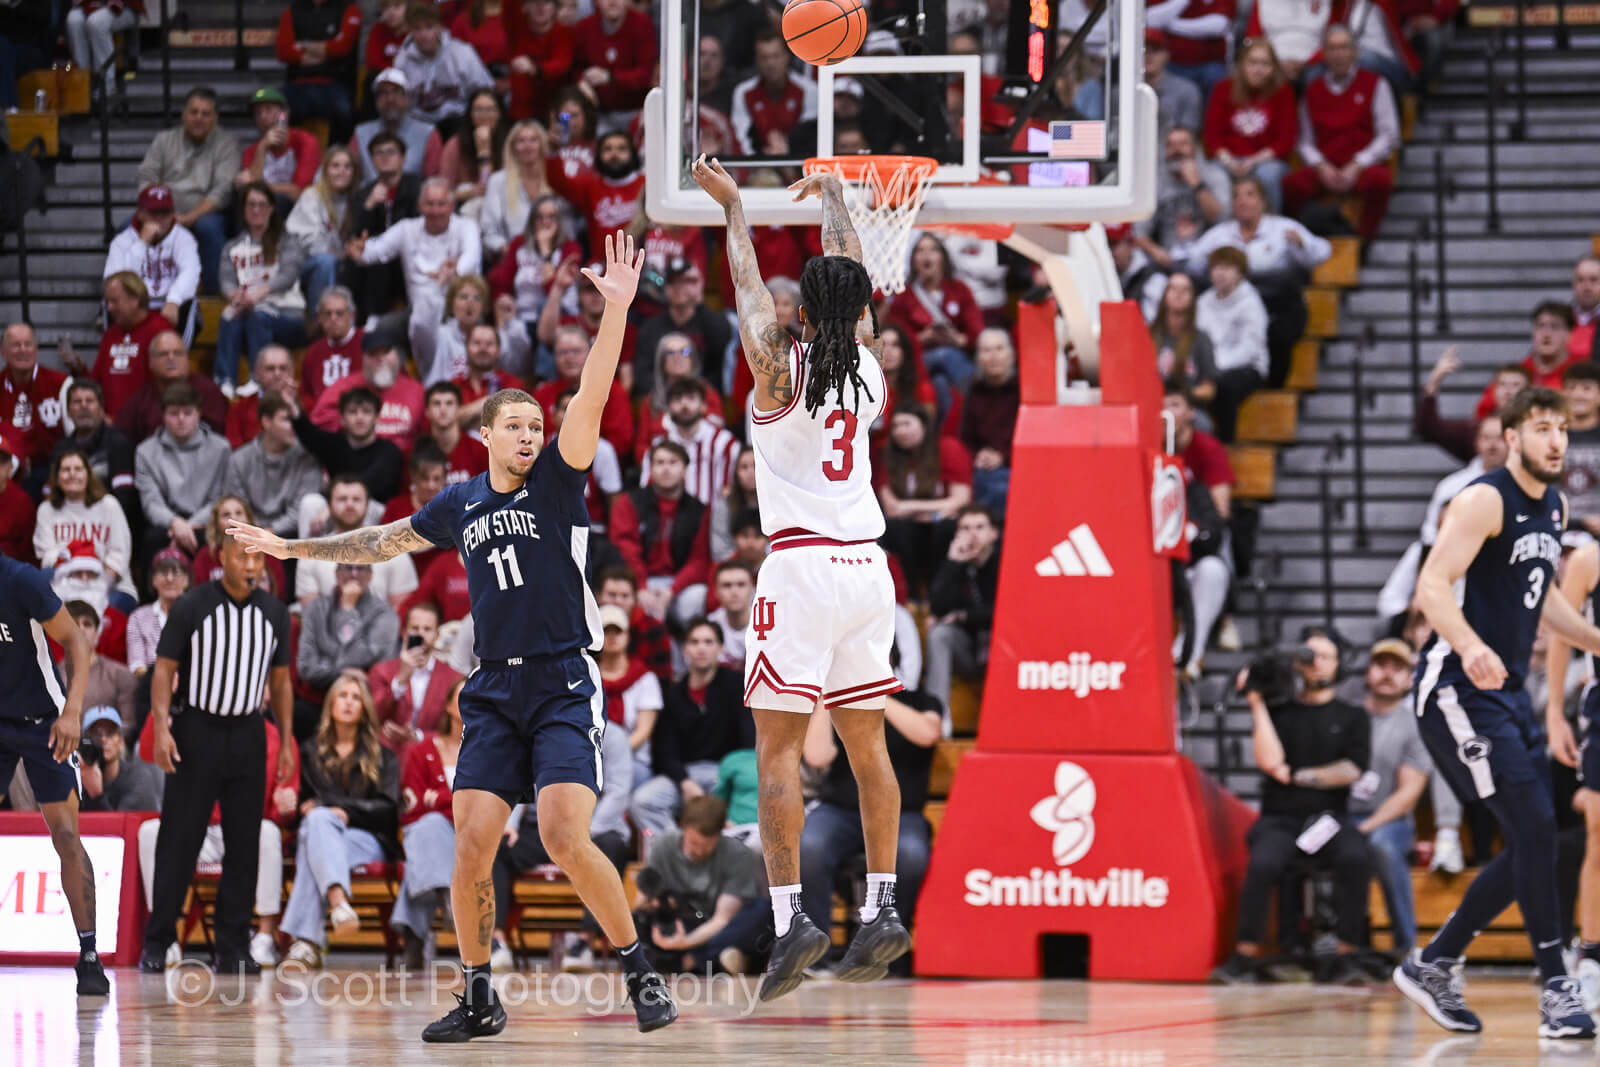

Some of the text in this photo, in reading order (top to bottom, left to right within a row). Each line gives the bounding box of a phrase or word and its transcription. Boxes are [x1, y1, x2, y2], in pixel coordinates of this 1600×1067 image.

[822, 409, 858, 482] 3
[463, 509, 540, 557] PENN STATE
[487, 544, 524, 591] 11
[1523, 566, 1545, 609] 3
[1018, 651, 1126, 698] meijer
[964, 867, 1169, 908] Smithville
